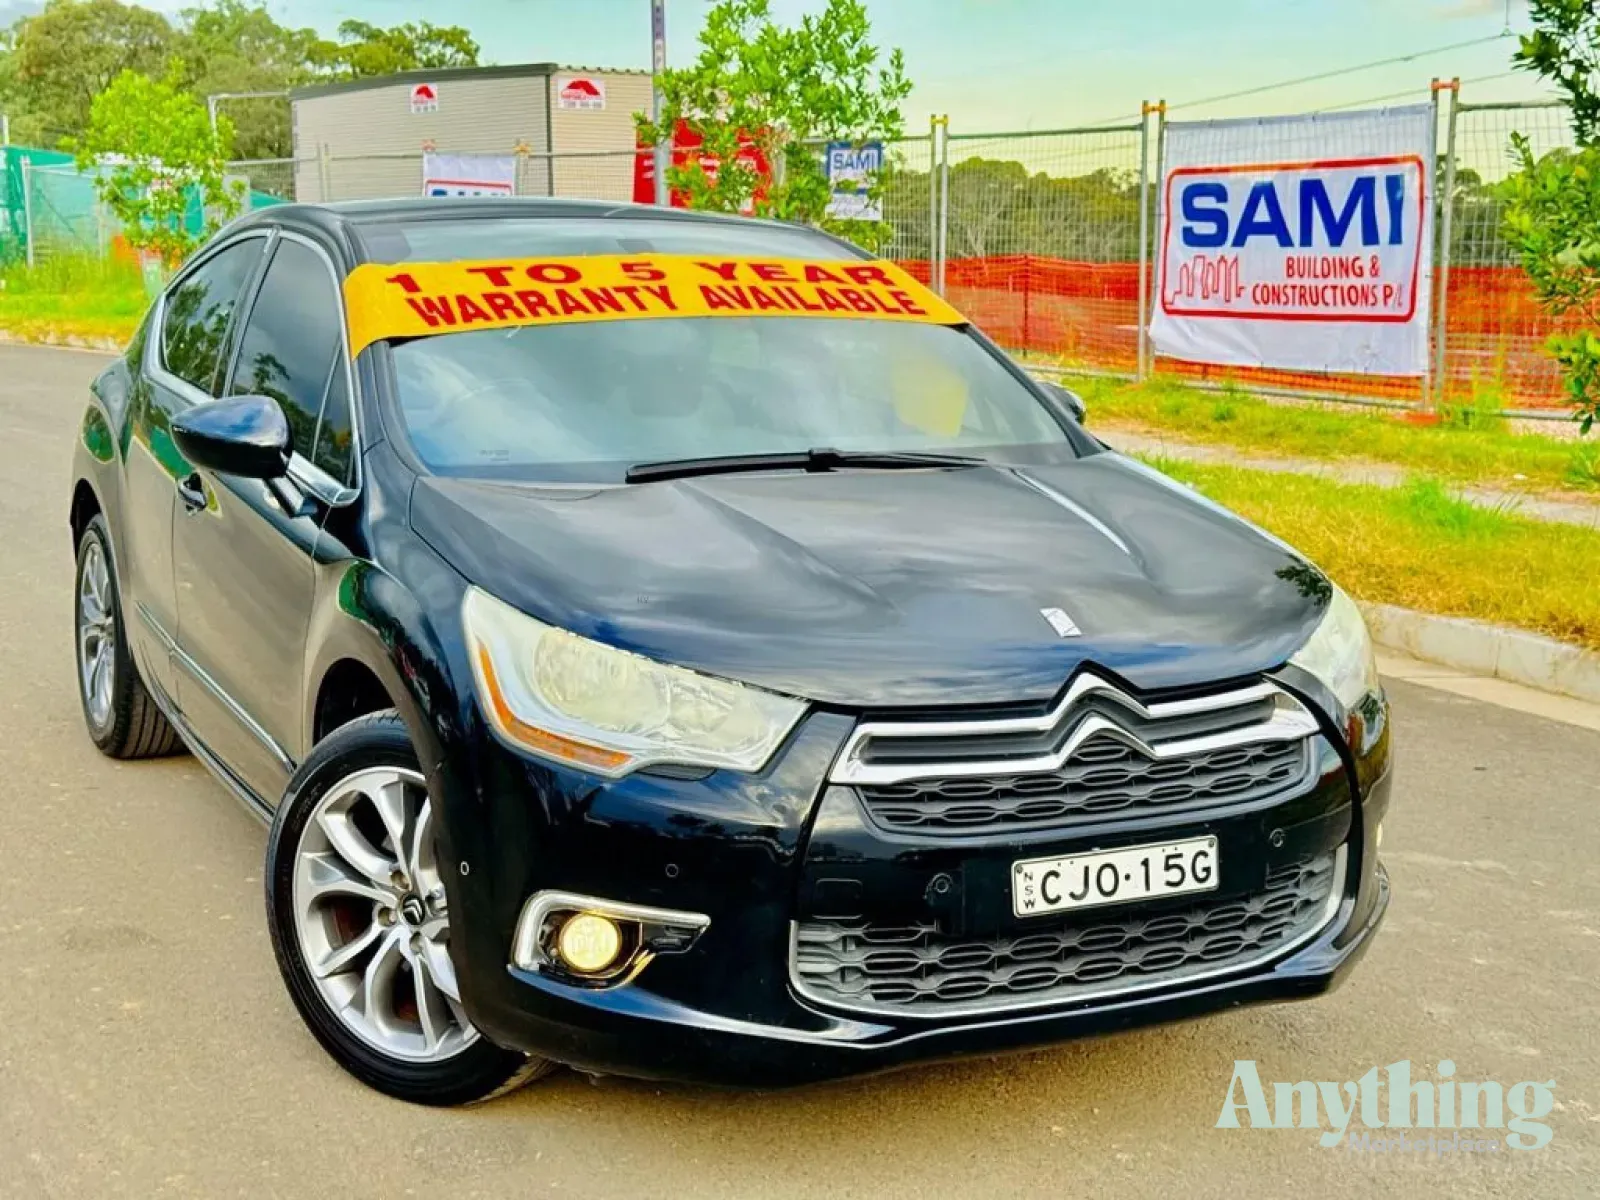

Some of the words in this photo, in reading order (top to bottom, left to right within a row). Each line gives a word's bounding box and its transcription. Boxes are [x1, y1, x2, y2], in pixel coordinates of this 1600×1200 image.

[1181, 174, 1405, 248] SAMI
[386, 273, 422, 293] 1
[466, 264, 582, 287] TO
[620, 262, 666, 281] 5
[694, 262, 895, 286] YEAR
[1285, 255, 1365, 279] BUILDING
[1370, 255, 1380, 278] &
[405, 285, 678, 327] WARRANTY
[699, 285, 927, 315] AVAILABLE
[1252, 283, 1378, 307] CONSTRUCTIONS
